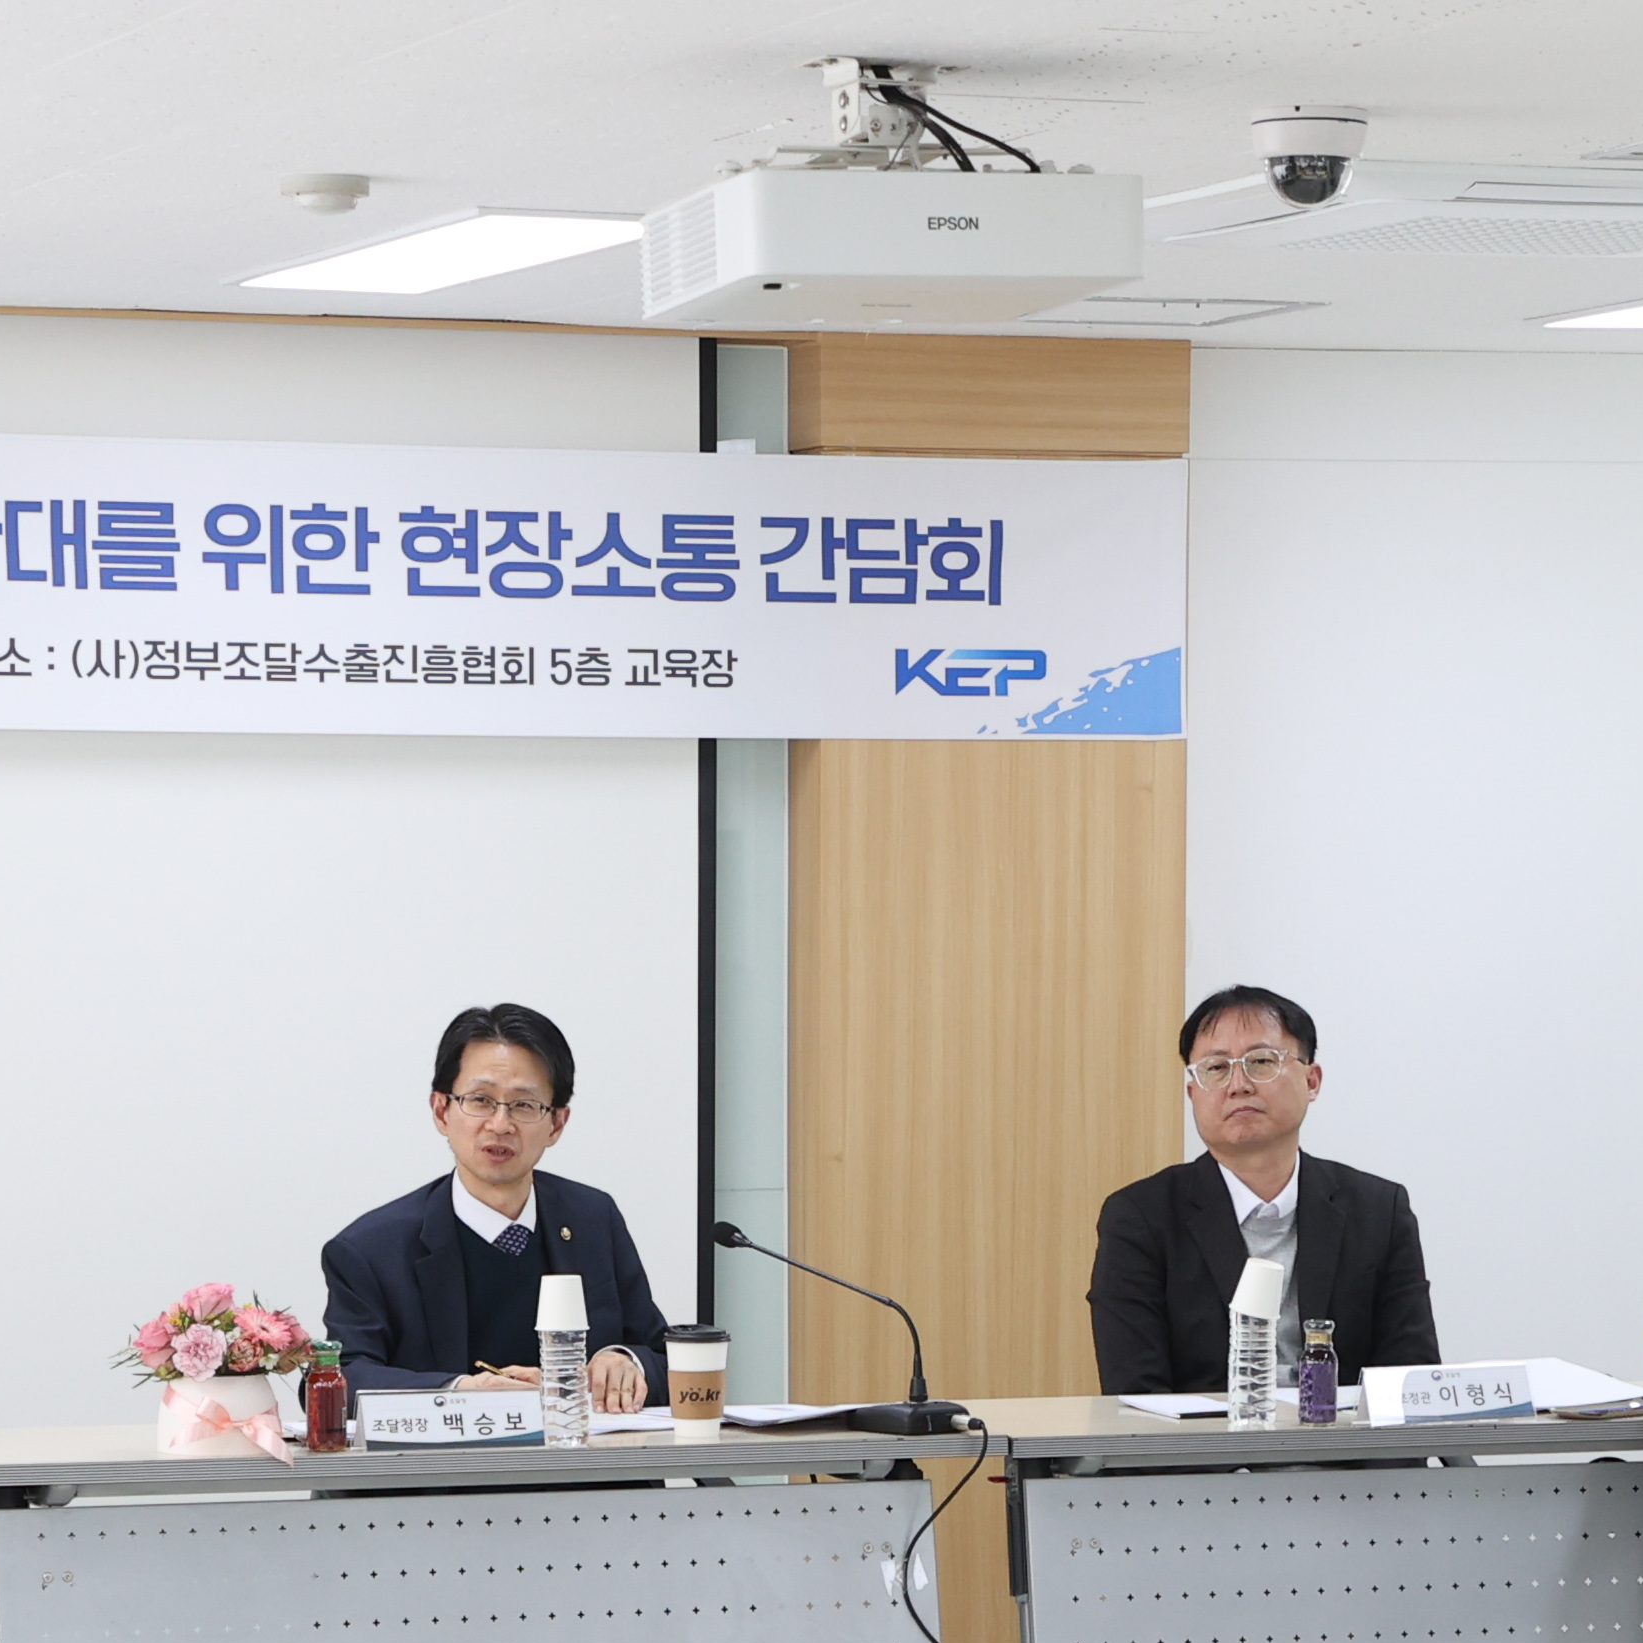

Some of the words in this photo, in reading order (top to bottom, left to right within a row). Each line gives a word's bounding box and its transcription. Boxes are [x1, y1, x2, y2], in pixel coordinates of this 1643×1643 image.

[927, 216, 979, 231] EPSON
[202, 502, 380, 596] 위한
[398, 505, 741, 603] 현장소통
[759, 516, 1004, 606] 간담회
[72, 639, 535, 686] (사)정부조달수출진흥협회
[550, 647, 612, 687] 5층
[624, 648, 739, 688] 교육장
[894, 647, 1048, 697] KEP
[371, 1417, 429, 1434] 조달청장
